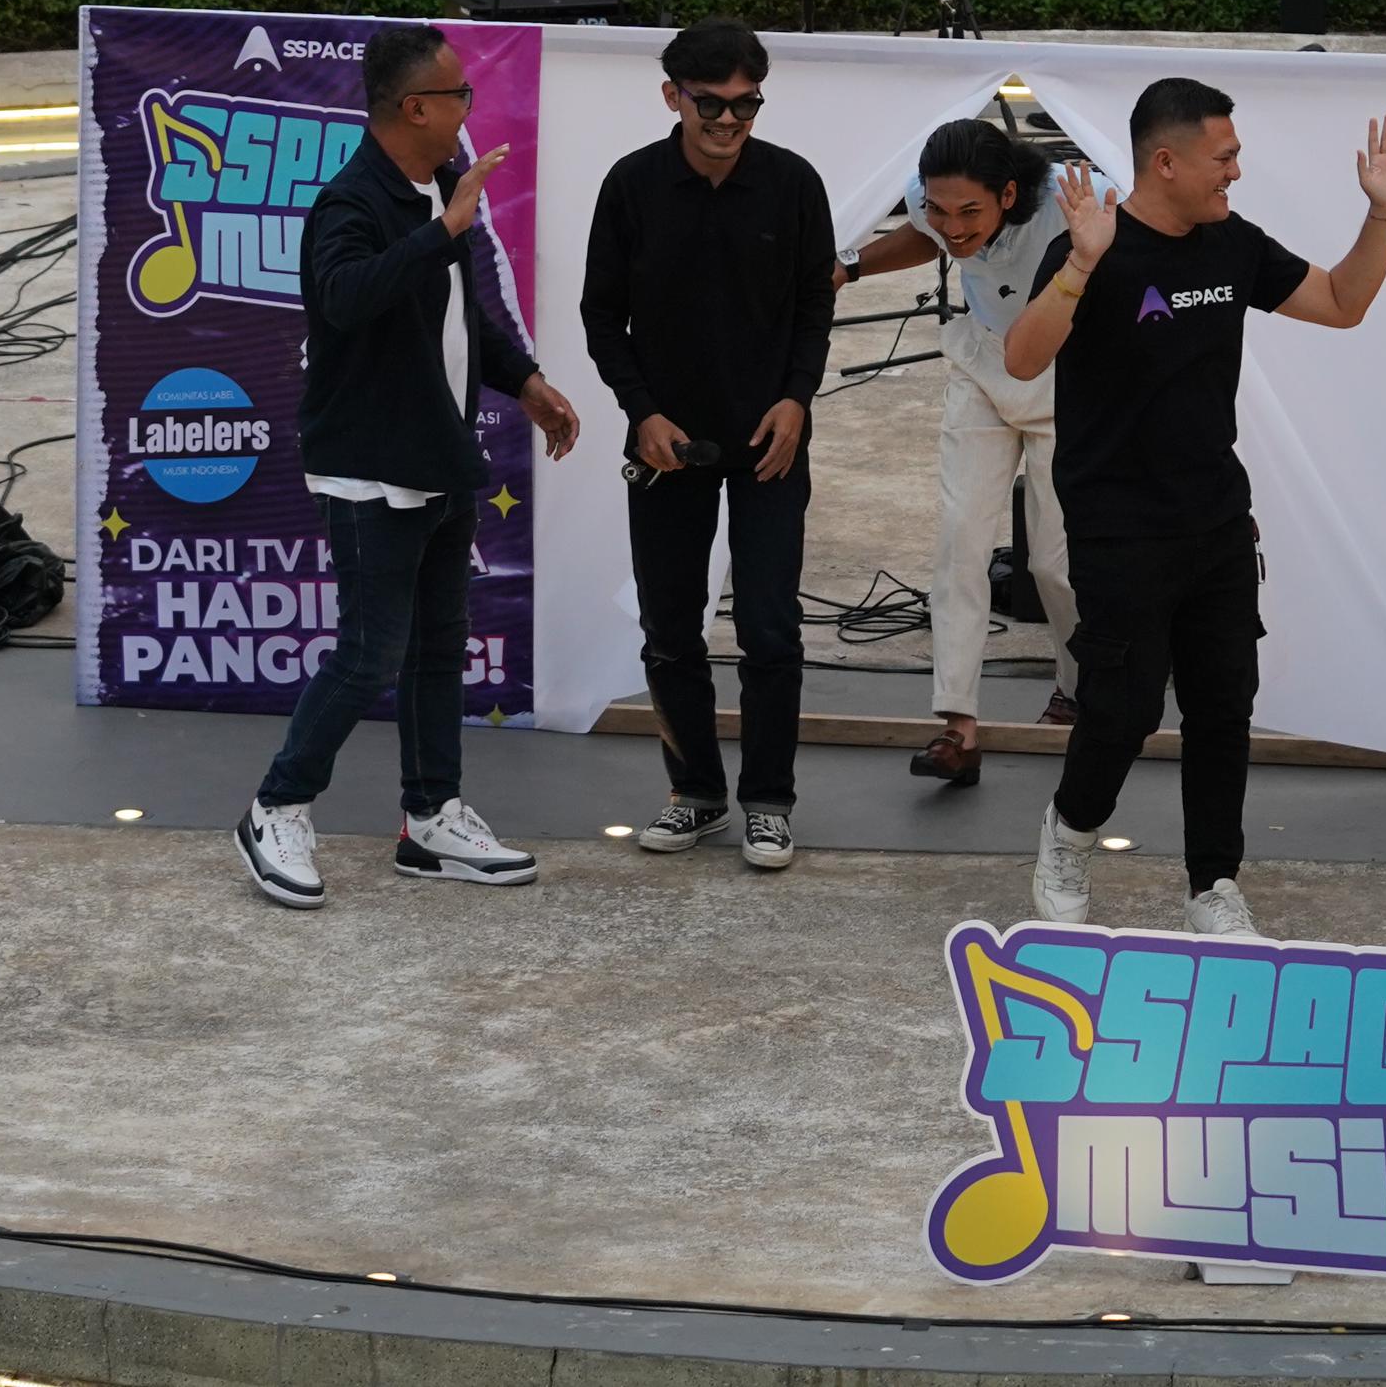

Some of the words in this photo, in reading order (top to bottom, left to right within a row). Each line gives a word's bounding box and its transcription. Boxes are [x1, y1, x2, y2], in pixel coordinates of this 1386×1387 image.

[283, 40, 366, 60] SSPACE
[1171, 285, 1234, 309] SSPACE
[157, 391, 208, 402] KOMUNITAS
[210, 390, 234, 400] LABEL
[129, 415, 270, 453] Labelers
[164, 467, 188, 476] MUSIK
[191, 465, 239, 475] INDONESIA
[130, 539, 235, 571] DARI
[247, 540, 304, 572] TV
